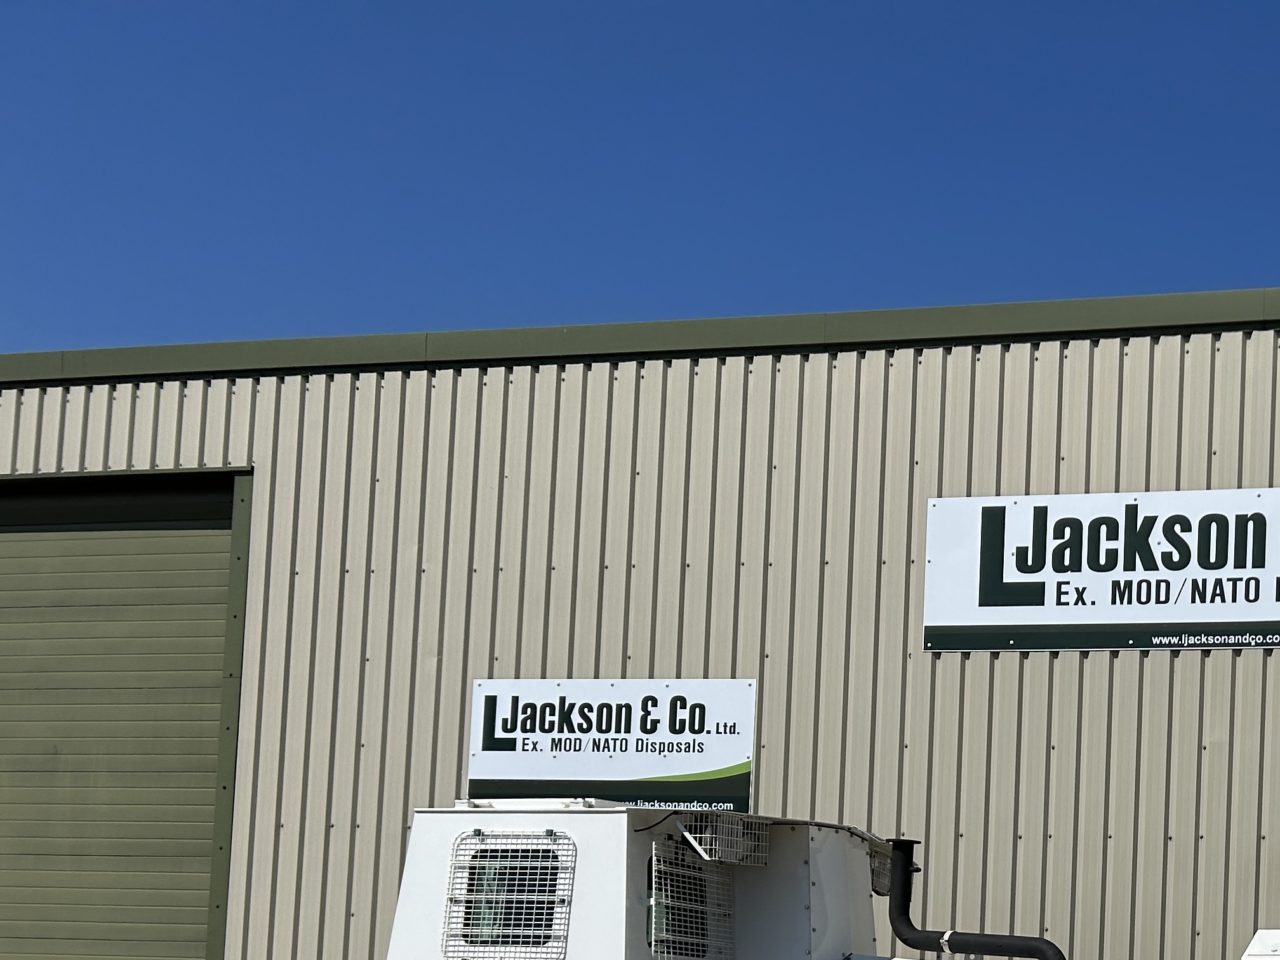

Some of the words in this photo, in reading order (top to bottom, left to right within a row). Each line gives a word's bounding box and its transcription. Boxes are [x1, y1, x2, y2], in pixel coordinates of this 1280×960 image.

[1055, 580, 1096, 607] Ex.
[1110, 576, 1261, 606] MOD/NATO
[639, 695, 661, 735] &
[668, 695, 712, 735] Co.
[715, 722, 741, 735] Ltd.
[521, 737, 544, 752] Ex.
[550, 737, 629, 753] MOD/NATO
[635, 737, 705, 756] Disposals
